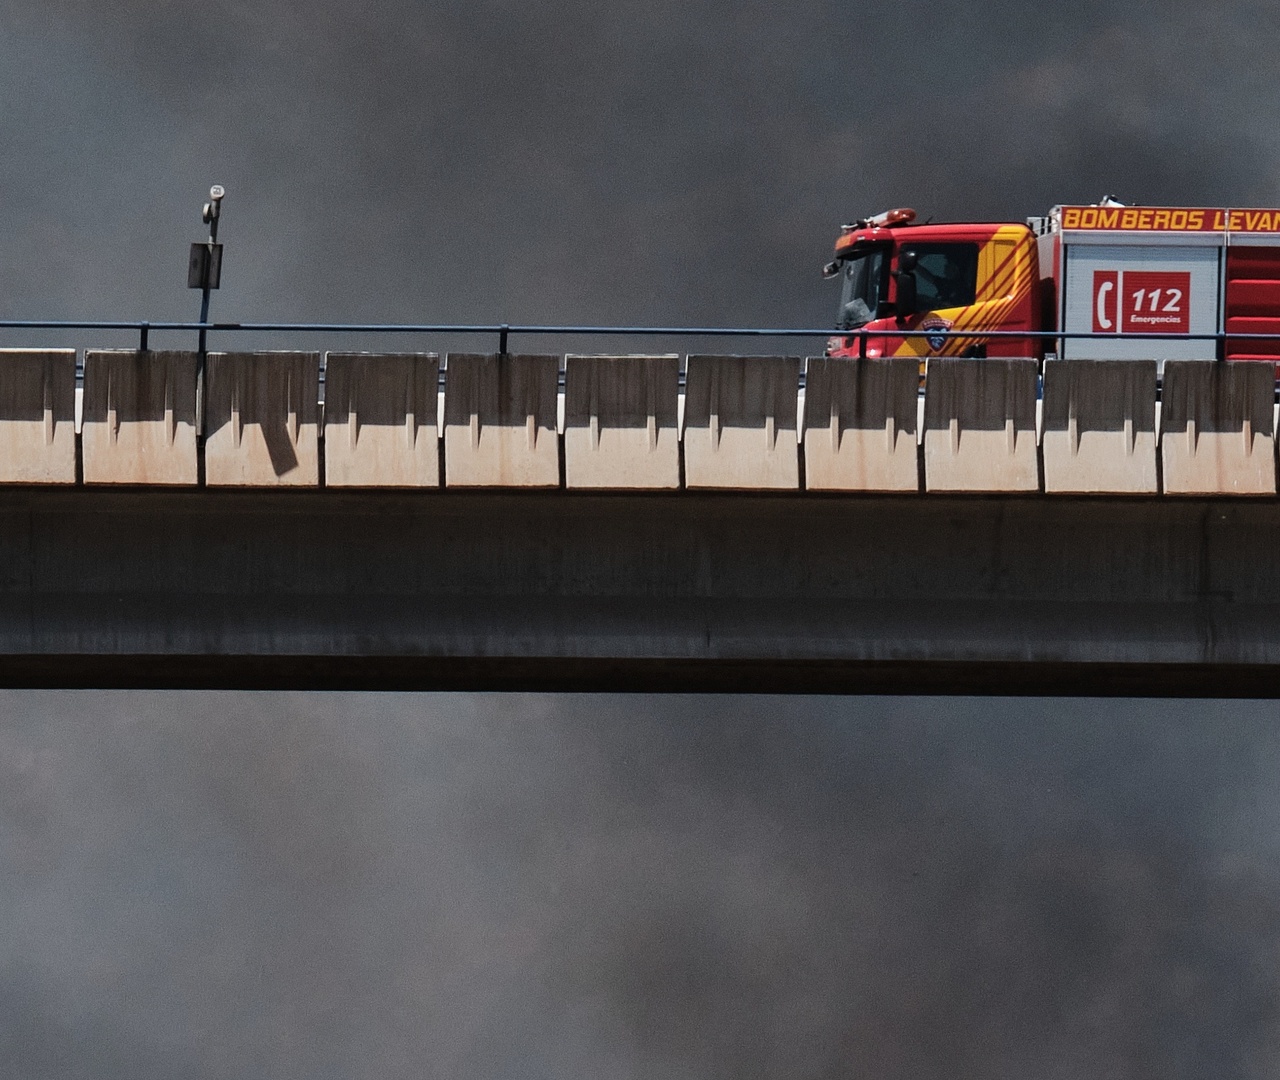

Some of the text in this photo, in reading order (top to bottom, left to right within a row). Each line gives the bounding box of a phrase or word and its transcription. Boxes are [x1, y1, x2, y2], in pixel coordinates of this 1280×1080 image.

[1063, 209, 1204, 230] BOMBEROS
[1132, 288, 1182, 312] 112
[1130, 314, 1181, 325] Emergencias
